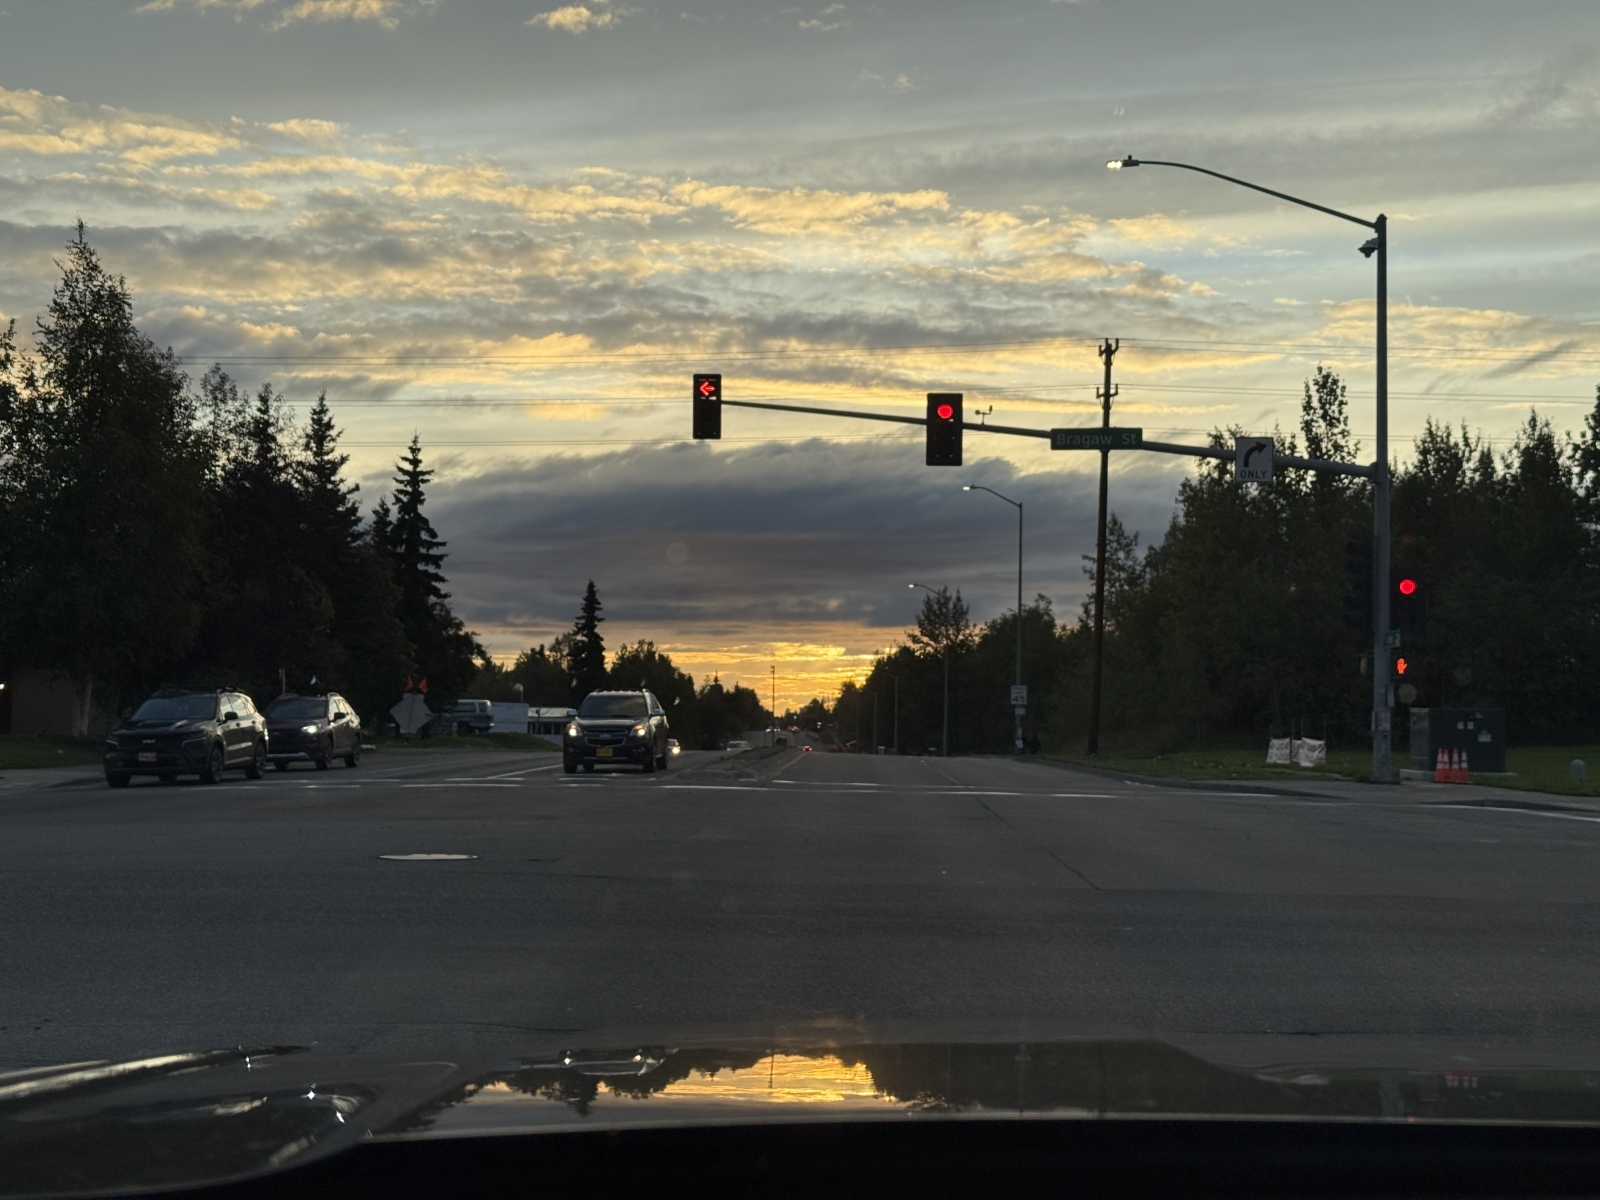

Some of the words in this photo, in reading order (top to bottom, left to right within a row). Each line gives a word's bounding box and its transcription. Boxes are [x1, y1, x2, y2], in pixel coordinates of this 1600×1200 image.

[1056, 433, 1112, 448] Bragaw
[1122, 433, 1136, 445] St
[1240, 469, 1268, 479] ONLY
[1012, 695, 1025, 703] 45
